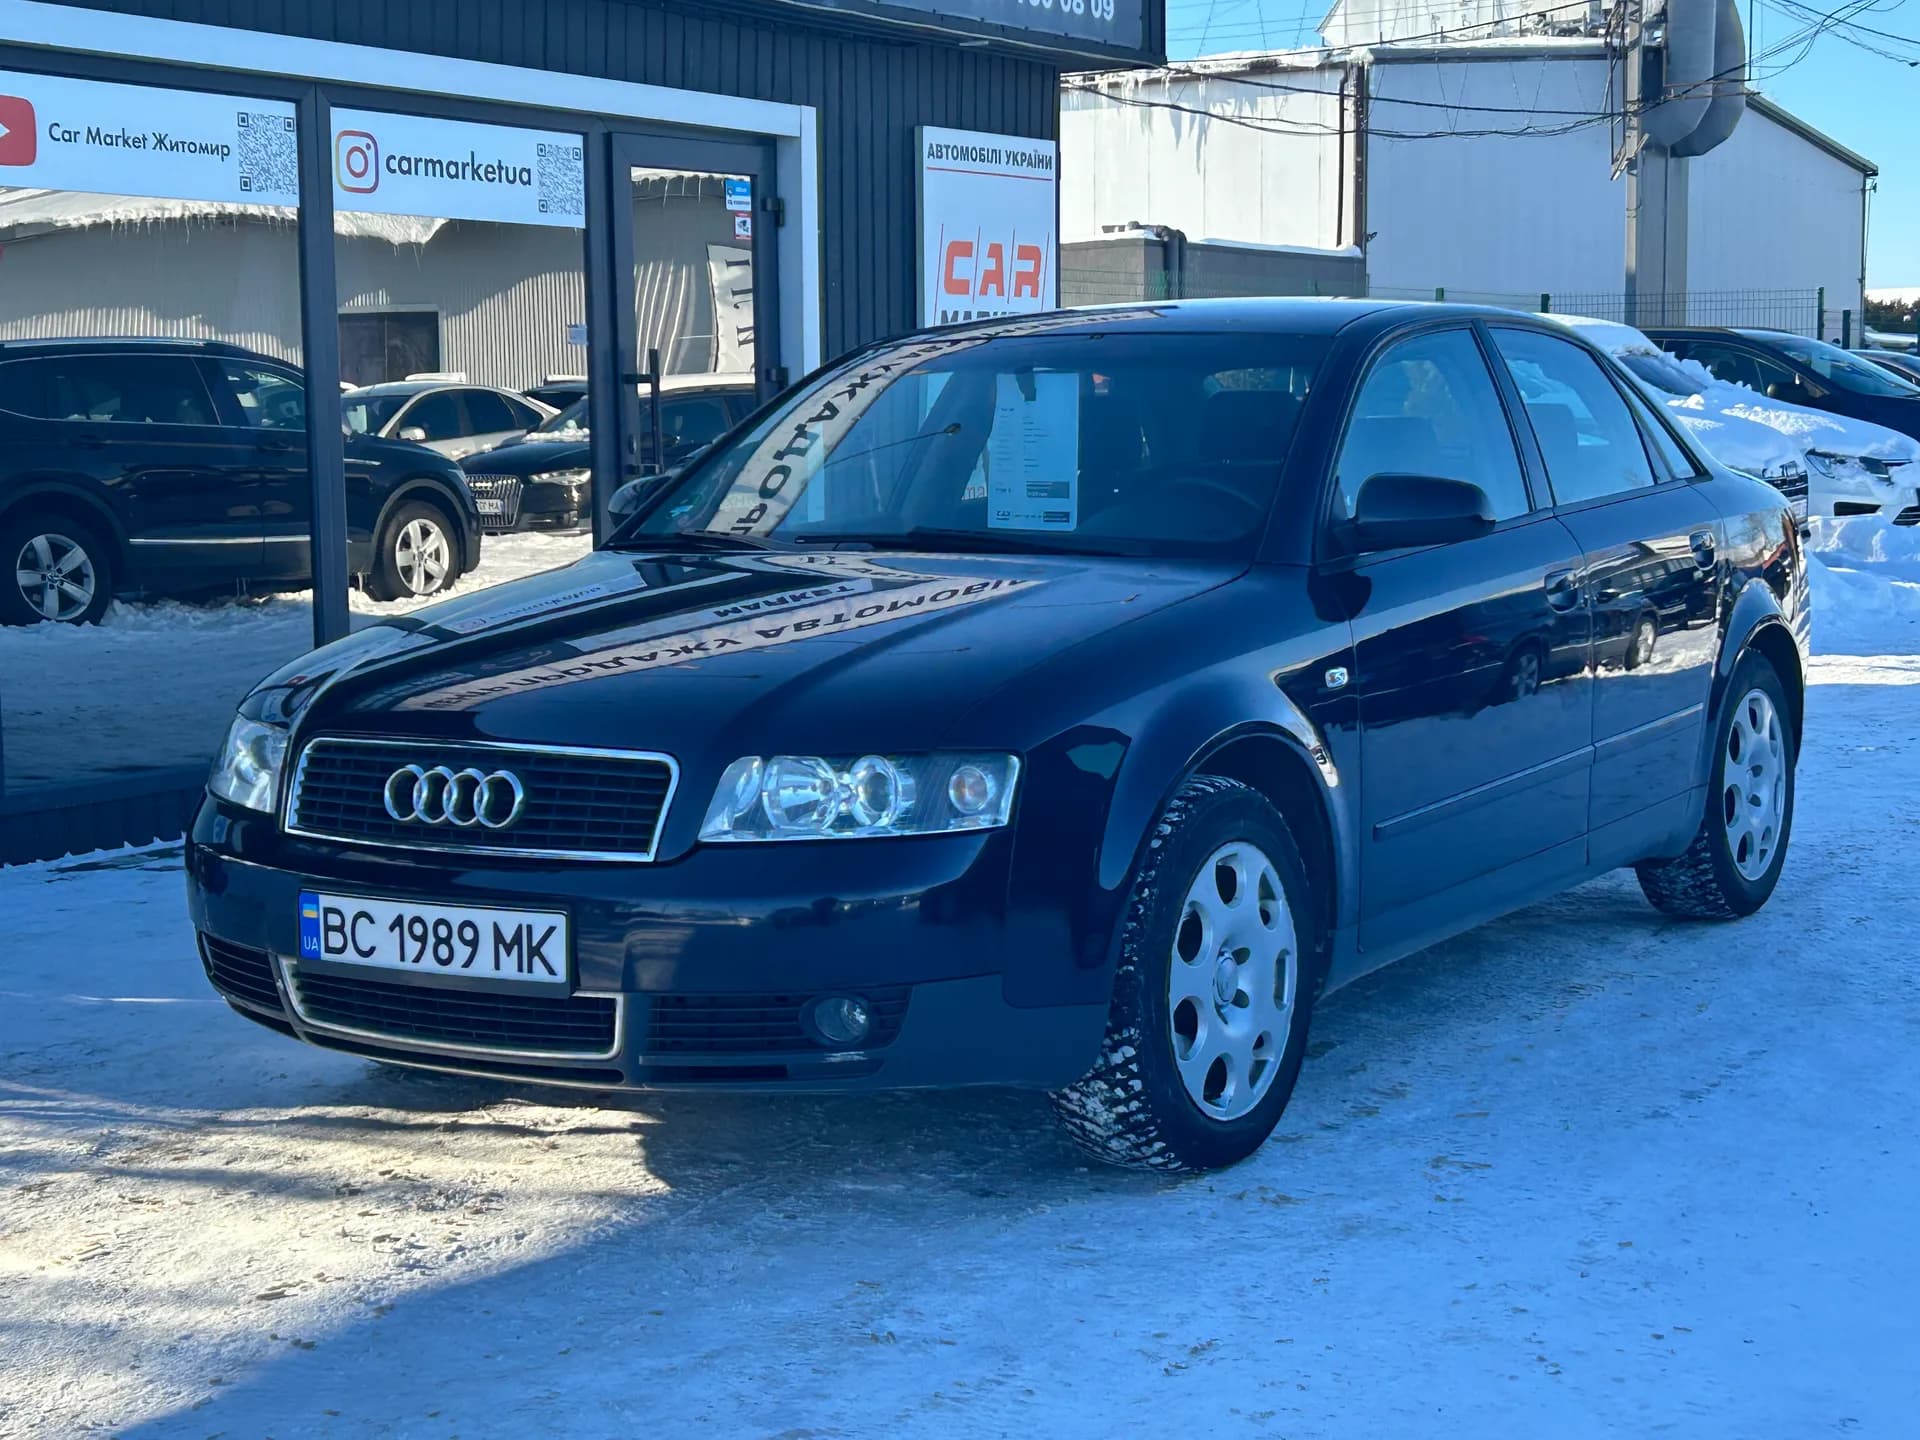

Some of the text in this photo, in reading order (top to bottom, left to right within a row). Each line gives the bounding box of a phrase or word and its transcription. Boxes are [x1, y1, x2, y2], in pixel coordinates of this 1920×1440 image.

[48, 122, 230, 161] Car Market Житомир
[926, 142, 1053, 171] АВТОМОБІЛІ УКРАЇНИ
[385, 150, 532, 186] carmarketua
[944, 241, 1042, 298] CAR
[304, 936, 318, 951] UA
[323, 907, 558, 976] BC 1989 MK
